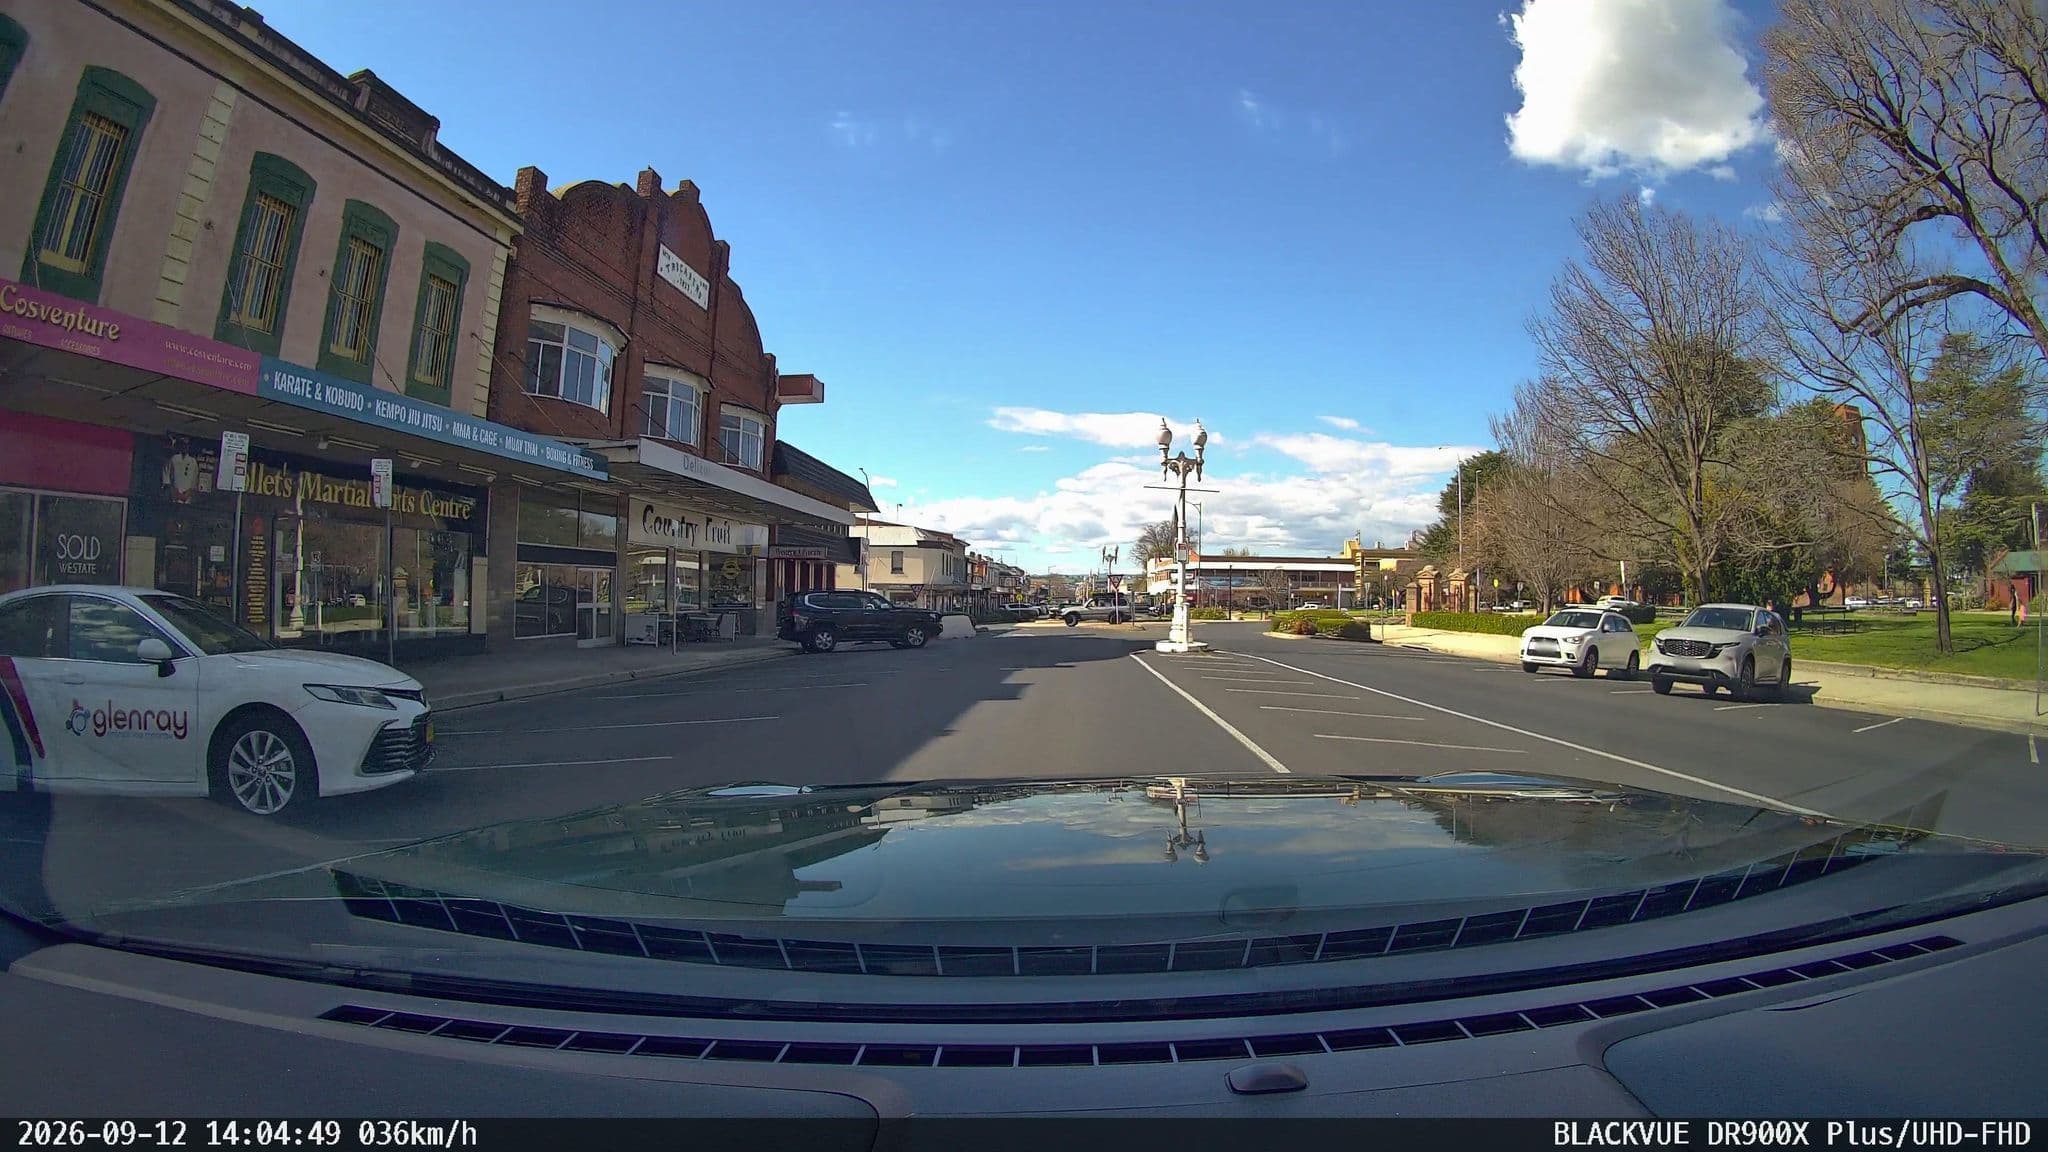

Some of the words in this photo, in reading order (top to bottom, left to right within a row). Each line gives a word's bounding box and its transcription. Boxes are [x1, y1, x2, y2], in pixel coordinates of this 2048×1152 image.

[1, 284, 120, 340] Cosventure
[274, 371, 313, 399] KARATE
[314, 383, 322, 401] &
[325, 385, 364, 413] KOBUDO
[375, 399, 407, 422] KEMPO
[407, 408, 421, 425] JIU
[422, 413, 443, 432] JITSU
[452, 422, 470, 439] MMA
[471, 427, 479, 440] &
[479, 429, 498, 447] CAGE
[505, 435, 523, 453] MUAY
[523, 440, 538, 456] THAI
[546, 447, 567, 464] BOXING
[572, 454, 594, 470] FITNESS
[299, 471, 371, 508] Martial
[420, 490, 471, 520] Centre
[56, 534, 100, 561] SOLD
[705, 517, 733, 544] Fruit
[93, 699, 188, 740] glenray
